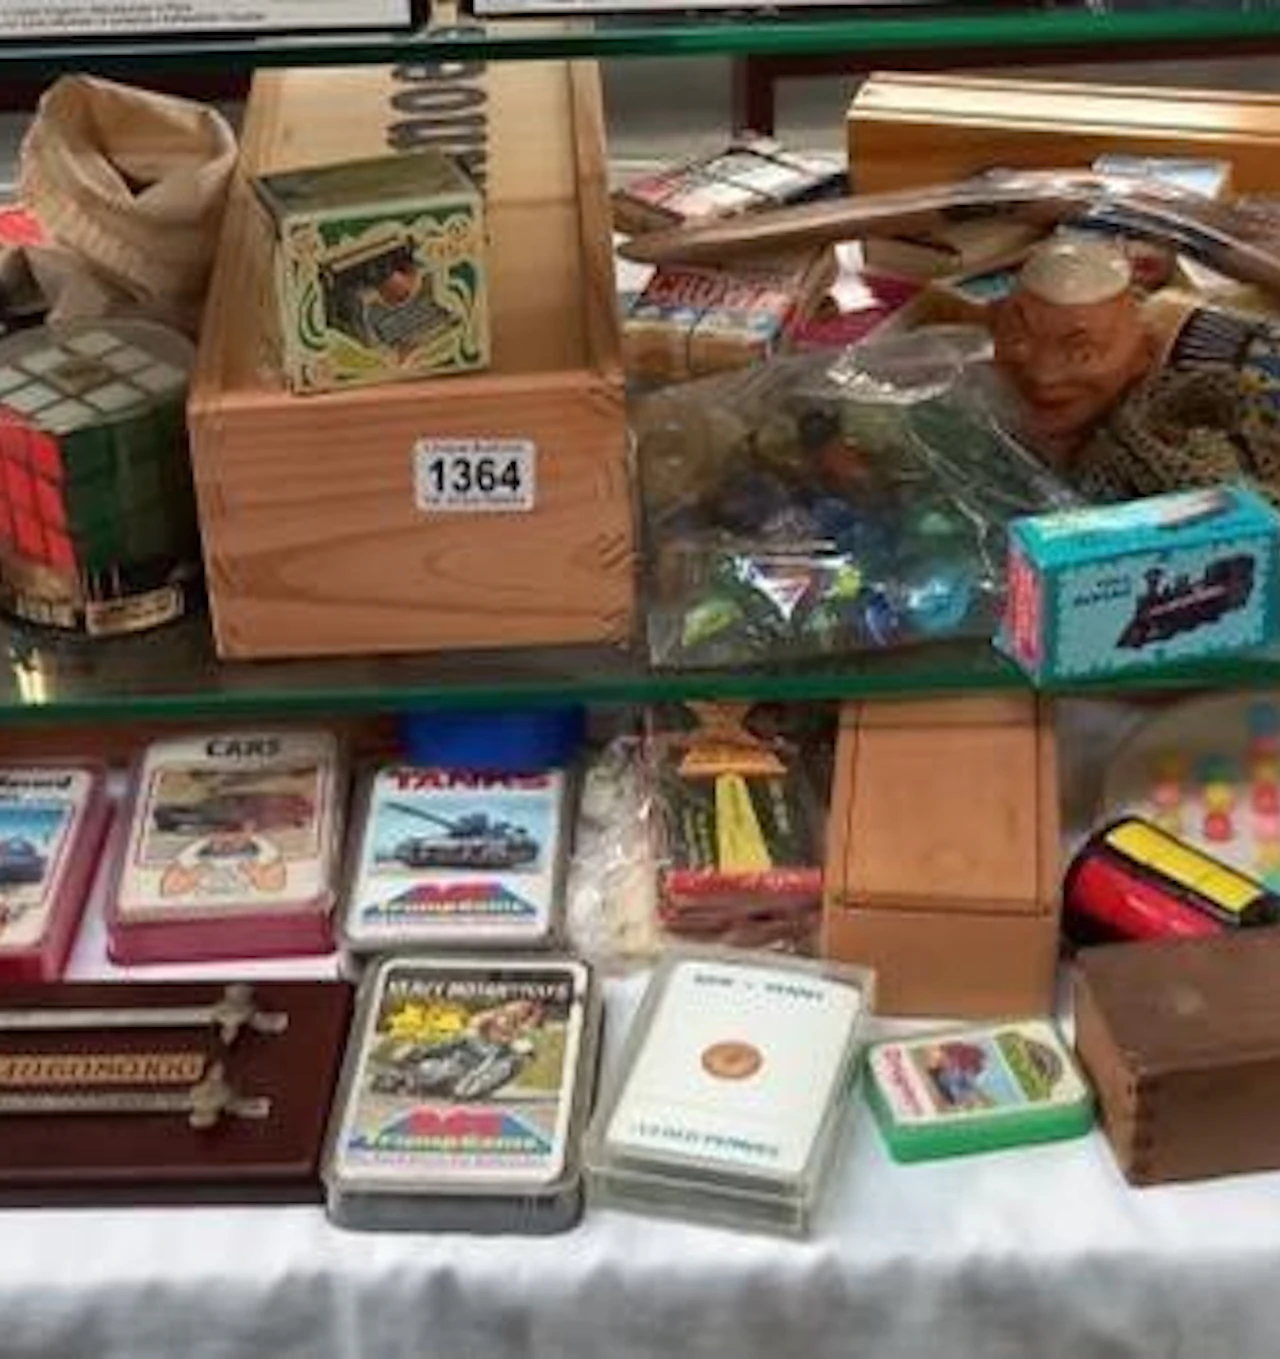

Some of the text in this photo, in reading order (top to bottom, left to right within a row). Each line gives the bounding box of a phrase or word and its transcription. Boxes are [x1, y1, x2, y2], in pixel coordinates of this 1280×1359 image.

[428, 458, 521, 492] 1364
[205, 736, 281, 758] CARS
[388, 770, 553, 791] TANKS
